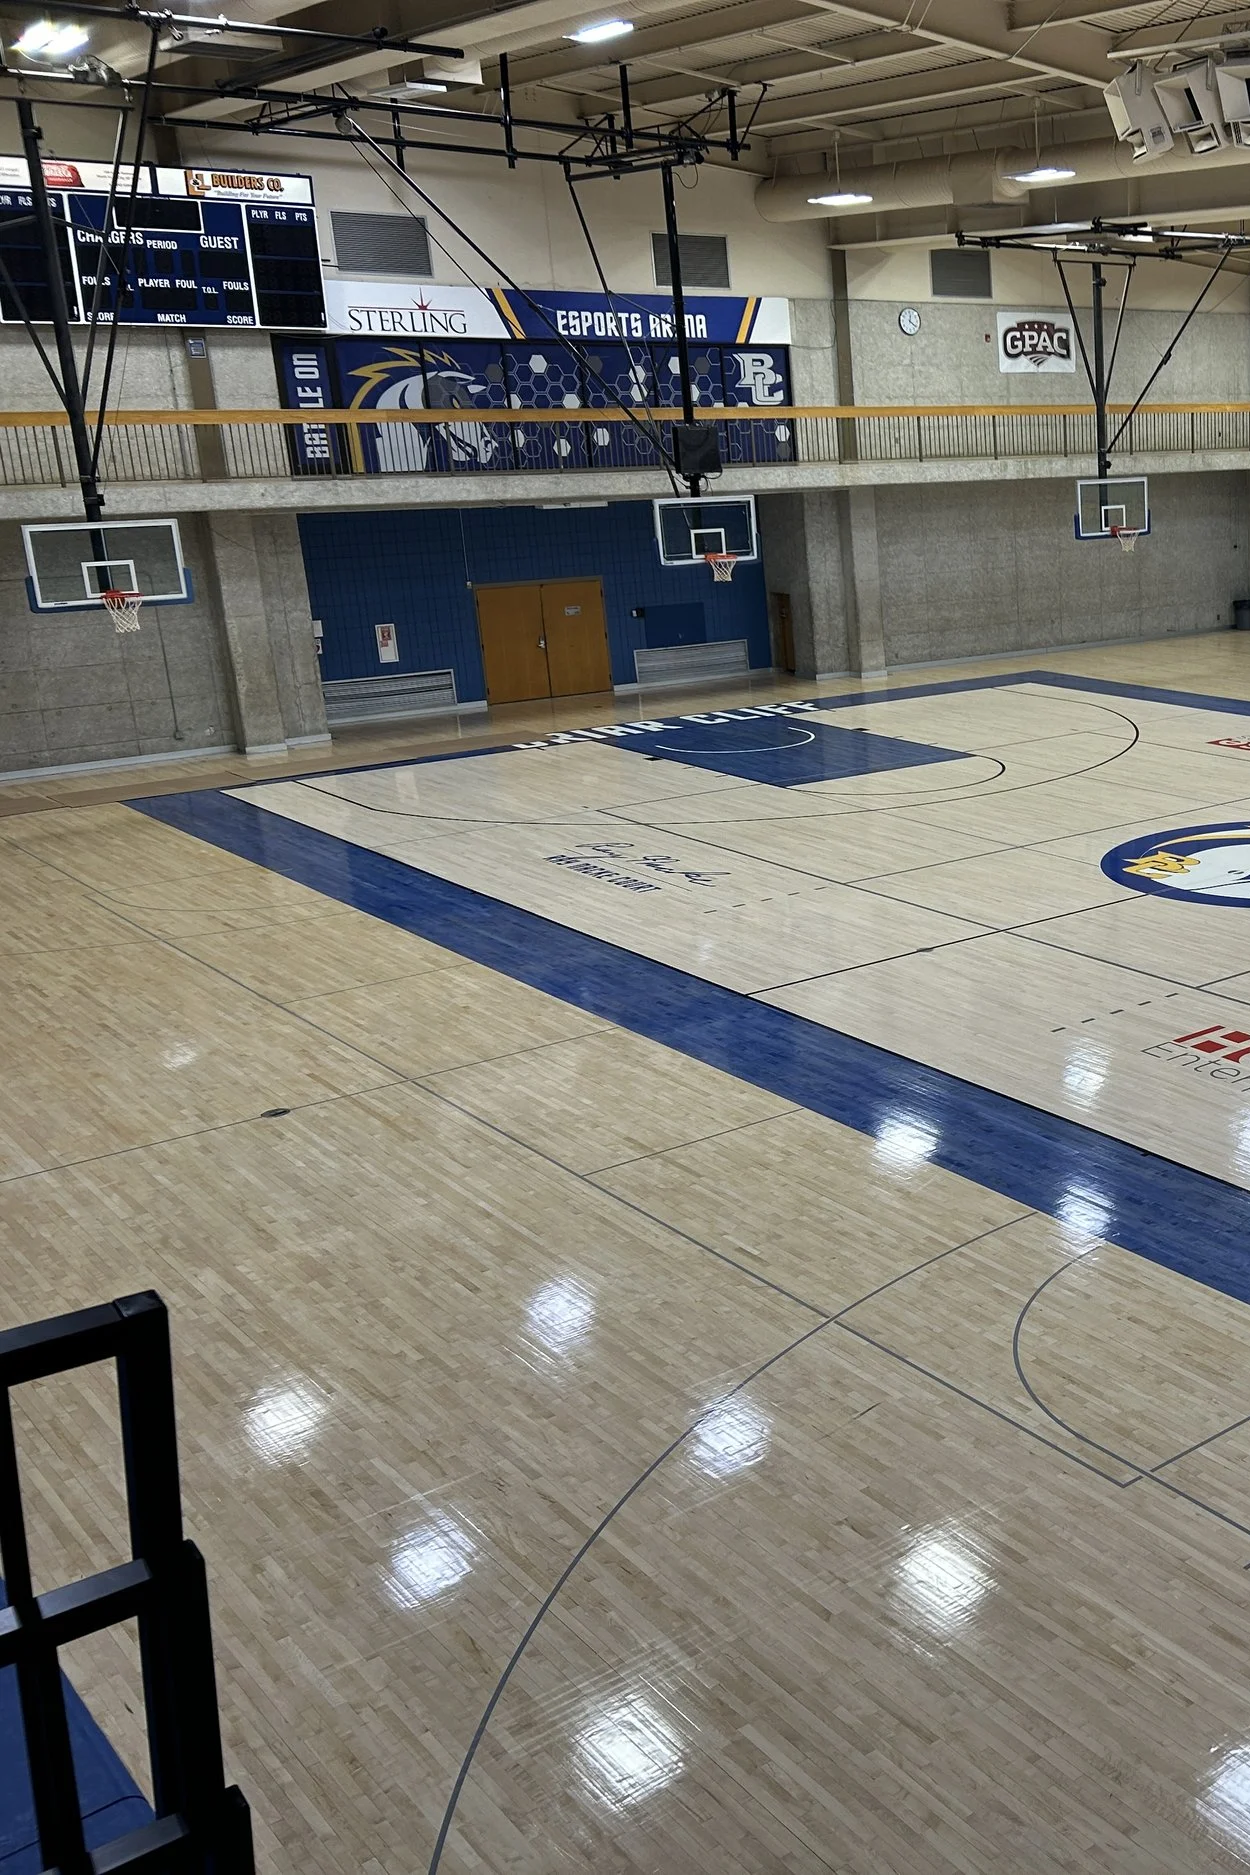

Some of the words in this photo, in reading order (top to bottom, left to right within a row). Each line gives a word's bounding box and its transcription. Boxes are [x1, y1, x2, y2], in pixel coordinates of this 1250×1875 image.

[211, 173, 265, 190] BUILDERS
[251, 209, 268, 219] PLYR
[275, 211, 287, 220] FLS
[295, 212, 307, 221] PTS
[146, 240, 178, 250] PERIOD
[200, 235, 239, 249] GUEST
[138, 278, 170, 288] PLAYER
[175, 279, 198, 289] FOUL
[222, 281, 249, 291] FOULS
[157, 313, 186, 323] MATCH
[226, 315, 254, 325] SCORE
[348, 309, 467, 335] STERLING
[556, 310, 642, 337] ESPORTS
[649, 313, 707, 338] ARNA
[1006, 330, 1068, 355] GPAC
[292, 353, 320, 379] ON
[732, 352, 784, 405] BC
[297, 387, 330, 458] BATLE
[679, 700, 820, 725] CLIFF
